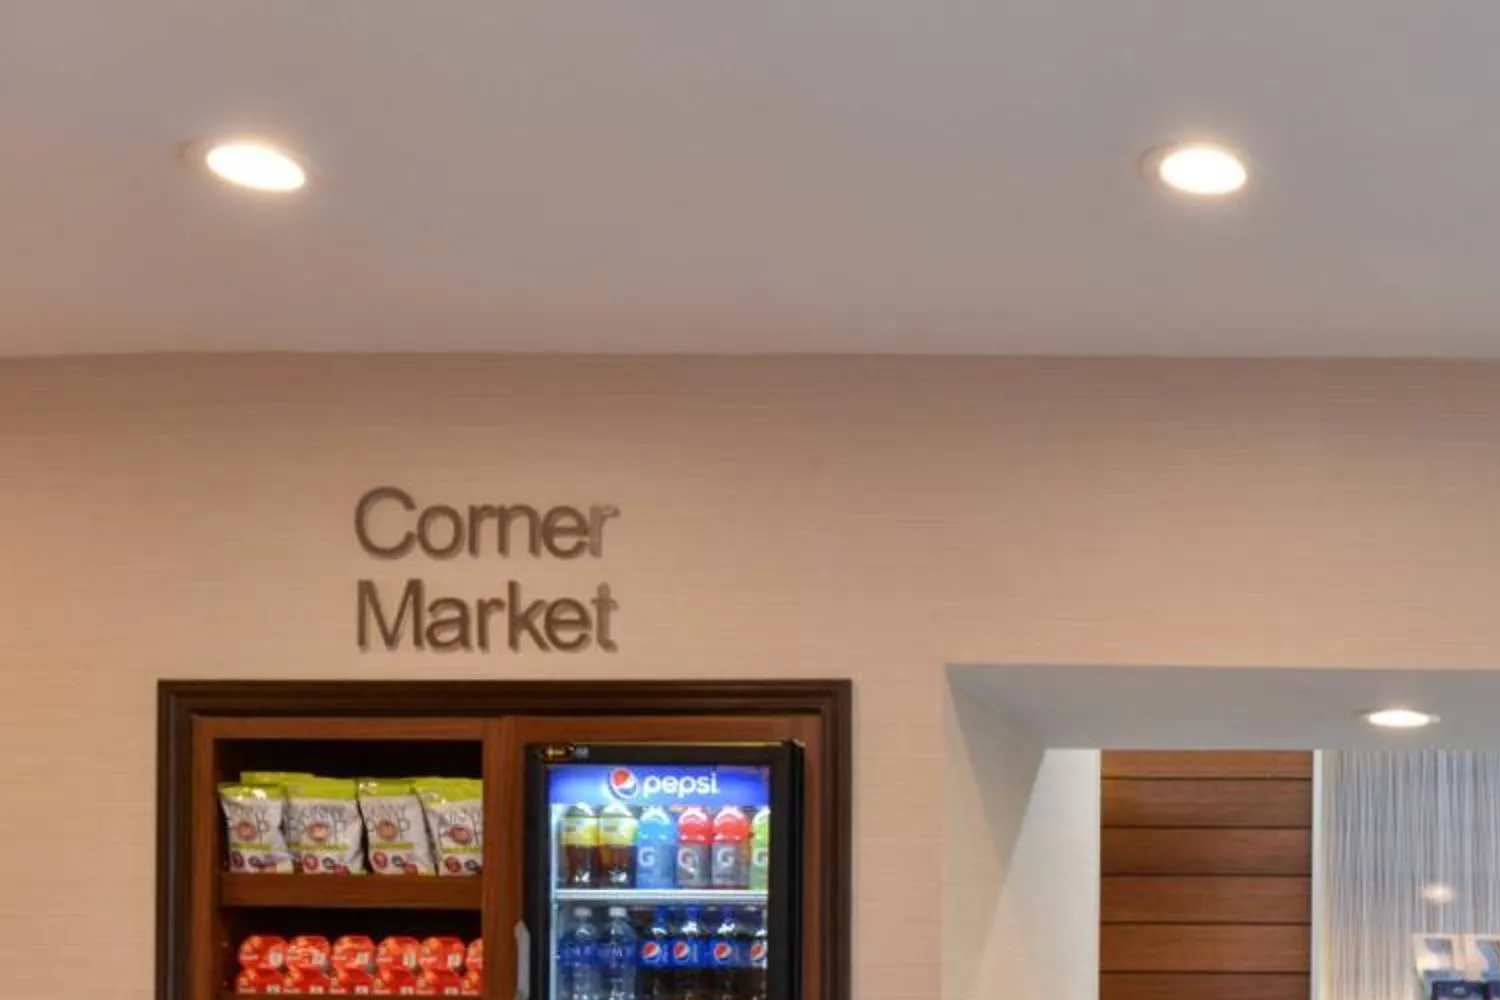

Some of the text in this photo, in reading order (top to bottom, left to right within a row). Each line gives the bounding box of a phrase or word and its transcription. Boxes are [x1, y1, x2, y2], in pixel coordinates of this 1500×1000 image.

[355, 486, 620, 560] Corner
[357, 578, 619, 653] Market
[643, 772, 720, 798] pepsi
[717, 845, 736, 868] G
